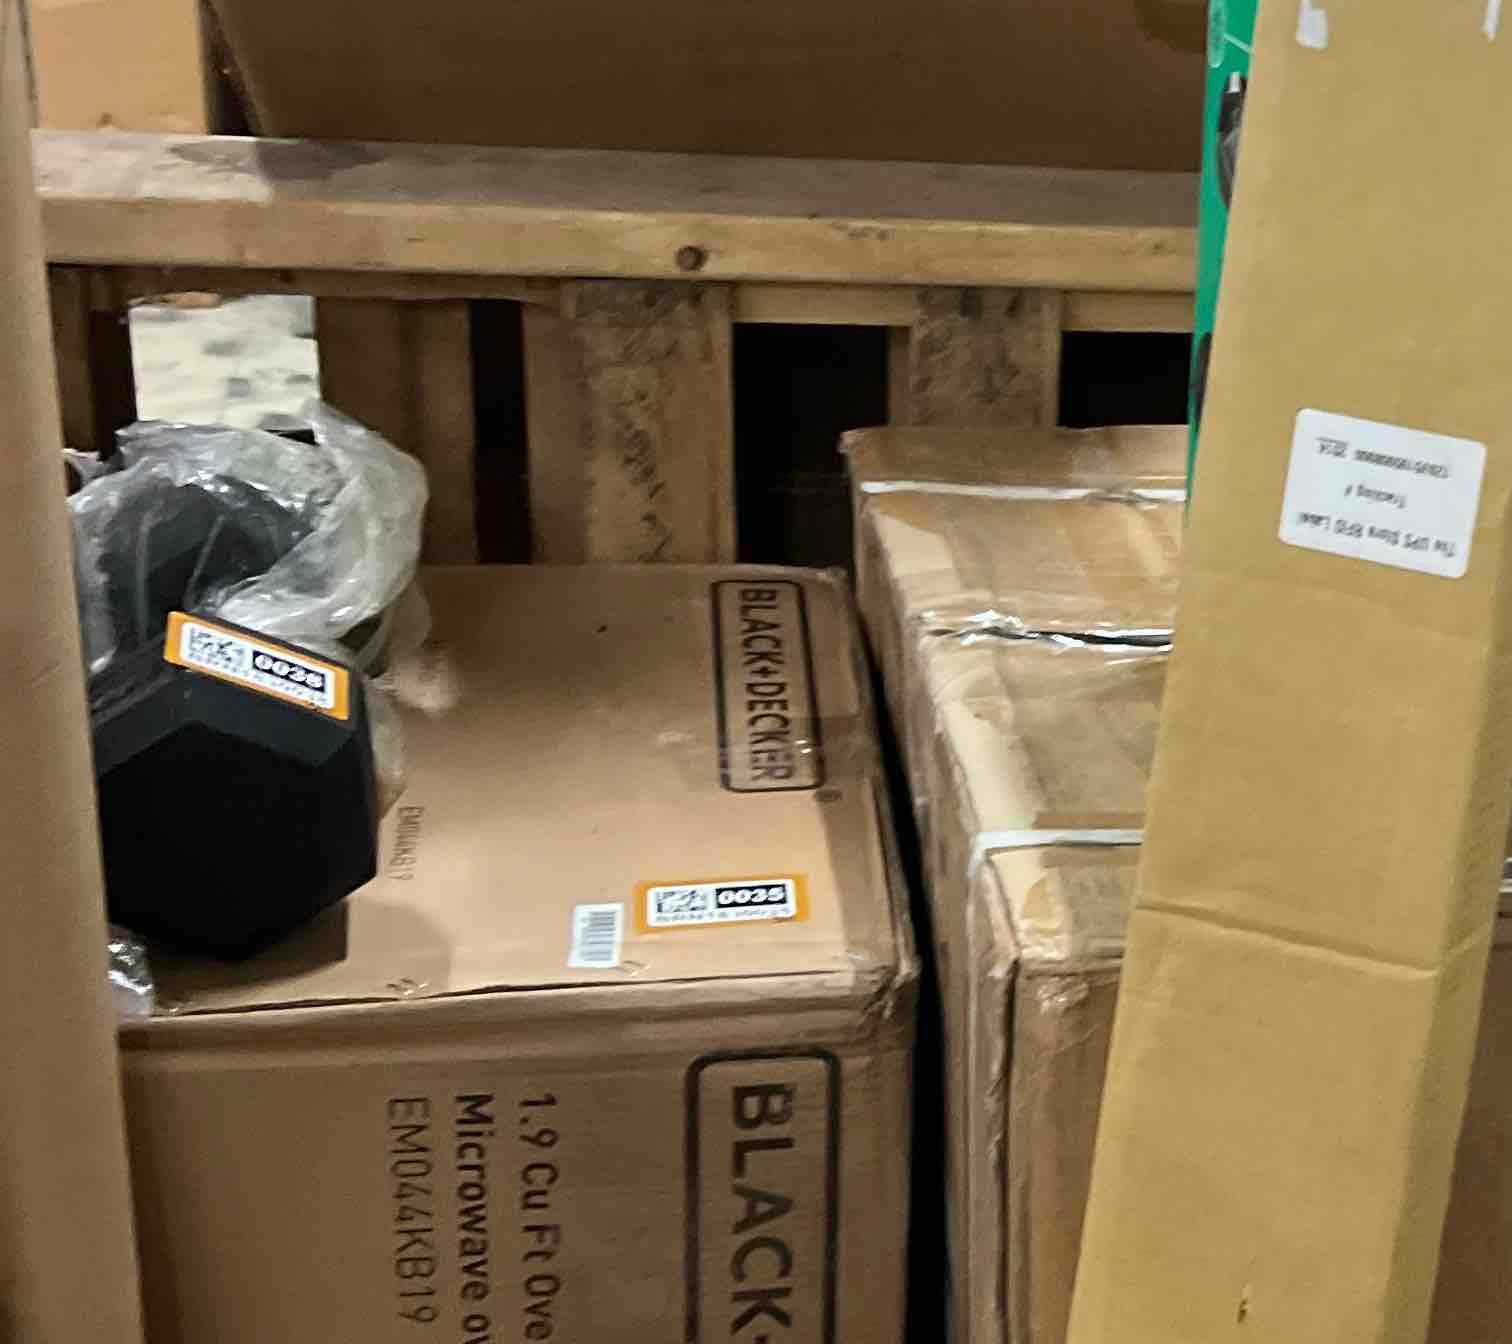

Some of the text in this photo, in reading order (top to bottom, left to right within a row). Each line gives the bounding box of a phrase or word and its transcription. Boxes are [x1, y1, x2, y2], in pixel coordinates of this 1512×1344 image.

[738, 587, 796, 781] BLACK+DECKER
[518, 1092, 557, 1149] 1.9
[386, 1094, 440, 1326] EM044KB19
[454, 1092, 496, 1302] Microwave
[518, 1159, 560, 1212] Cu
[520, 1223, 561, 1266] Ft
